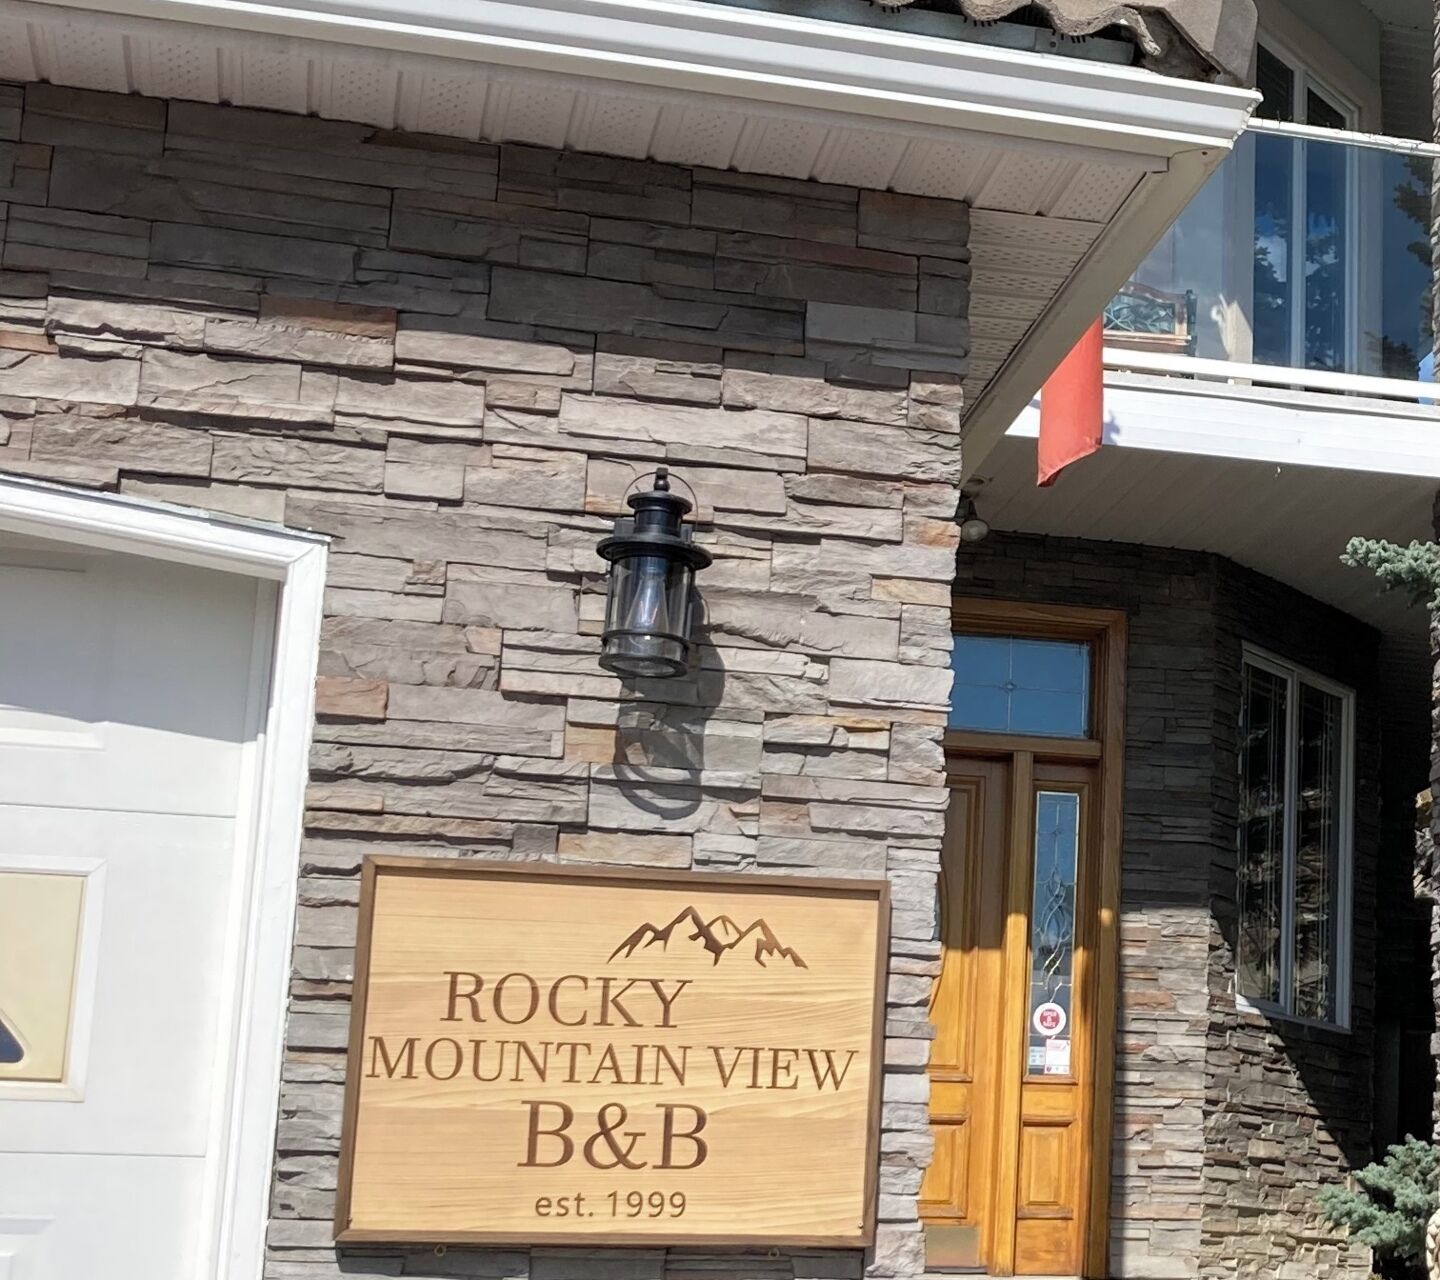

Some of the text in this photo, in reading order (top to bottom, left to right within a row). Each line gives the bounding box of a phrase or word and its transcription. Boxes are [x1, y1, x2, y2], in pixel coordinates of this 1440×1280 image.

[440, 971, 693, 1028] ROCKY
[365, 1036, 860, 1091] MOUNTAIN VIEW
[517, 1100, 709, 1171] B&B
[534, 1190, 687, 1218] est. 1999
